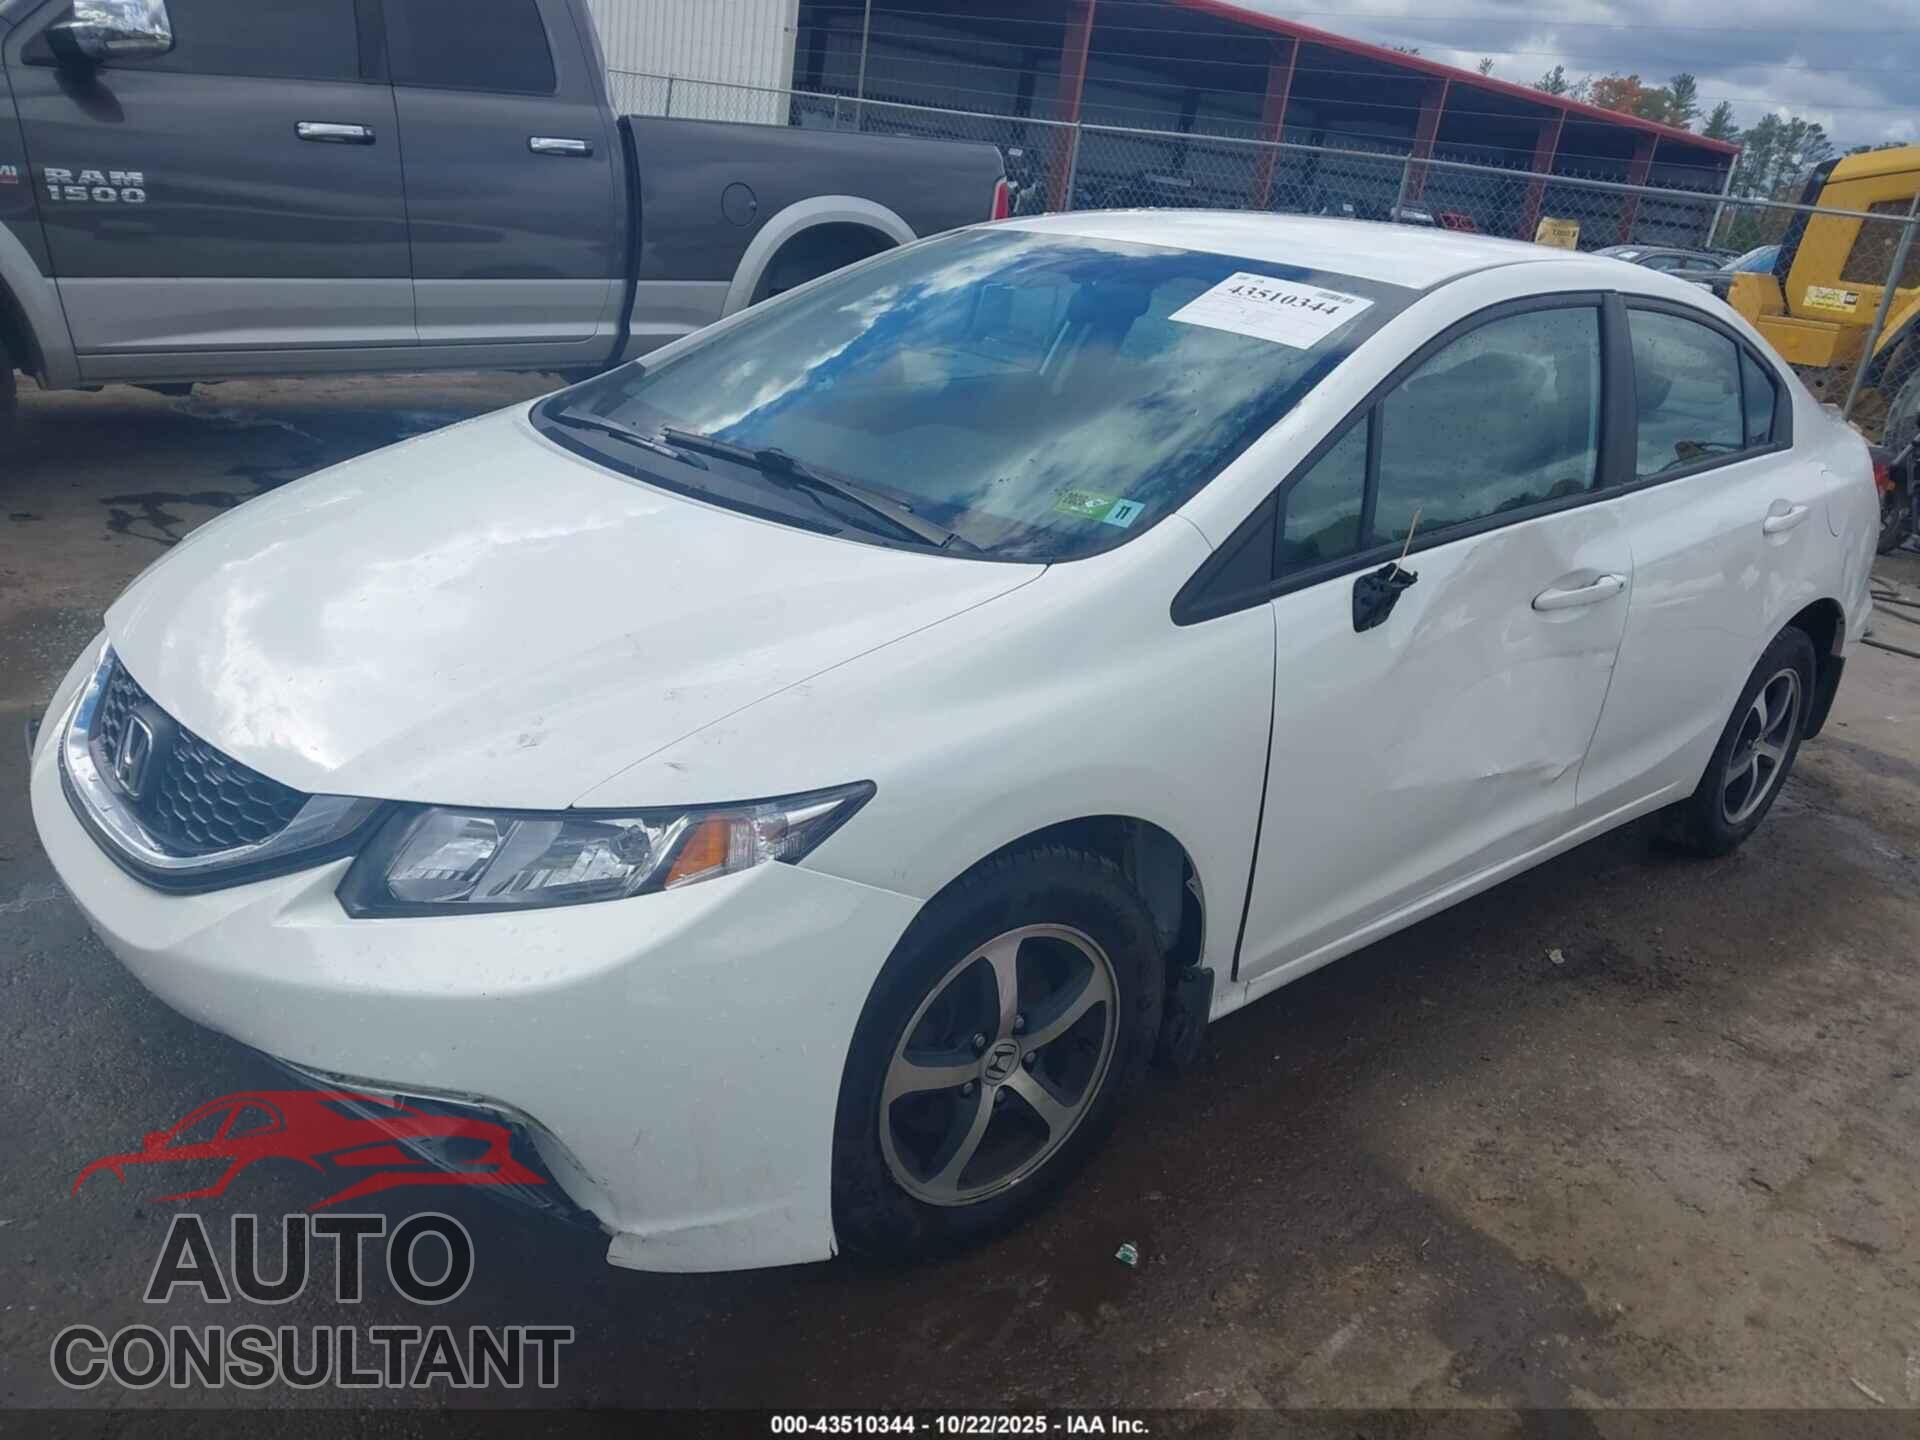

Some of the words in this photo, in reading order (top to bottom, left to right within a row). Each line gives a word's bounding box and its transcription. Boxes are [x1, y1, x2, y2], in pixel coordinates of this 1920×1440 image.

[43, 167, 144, 186] RAM
[47, 185, 147, 203] 1500
[1228, 285, 1340, 315] 43510344
